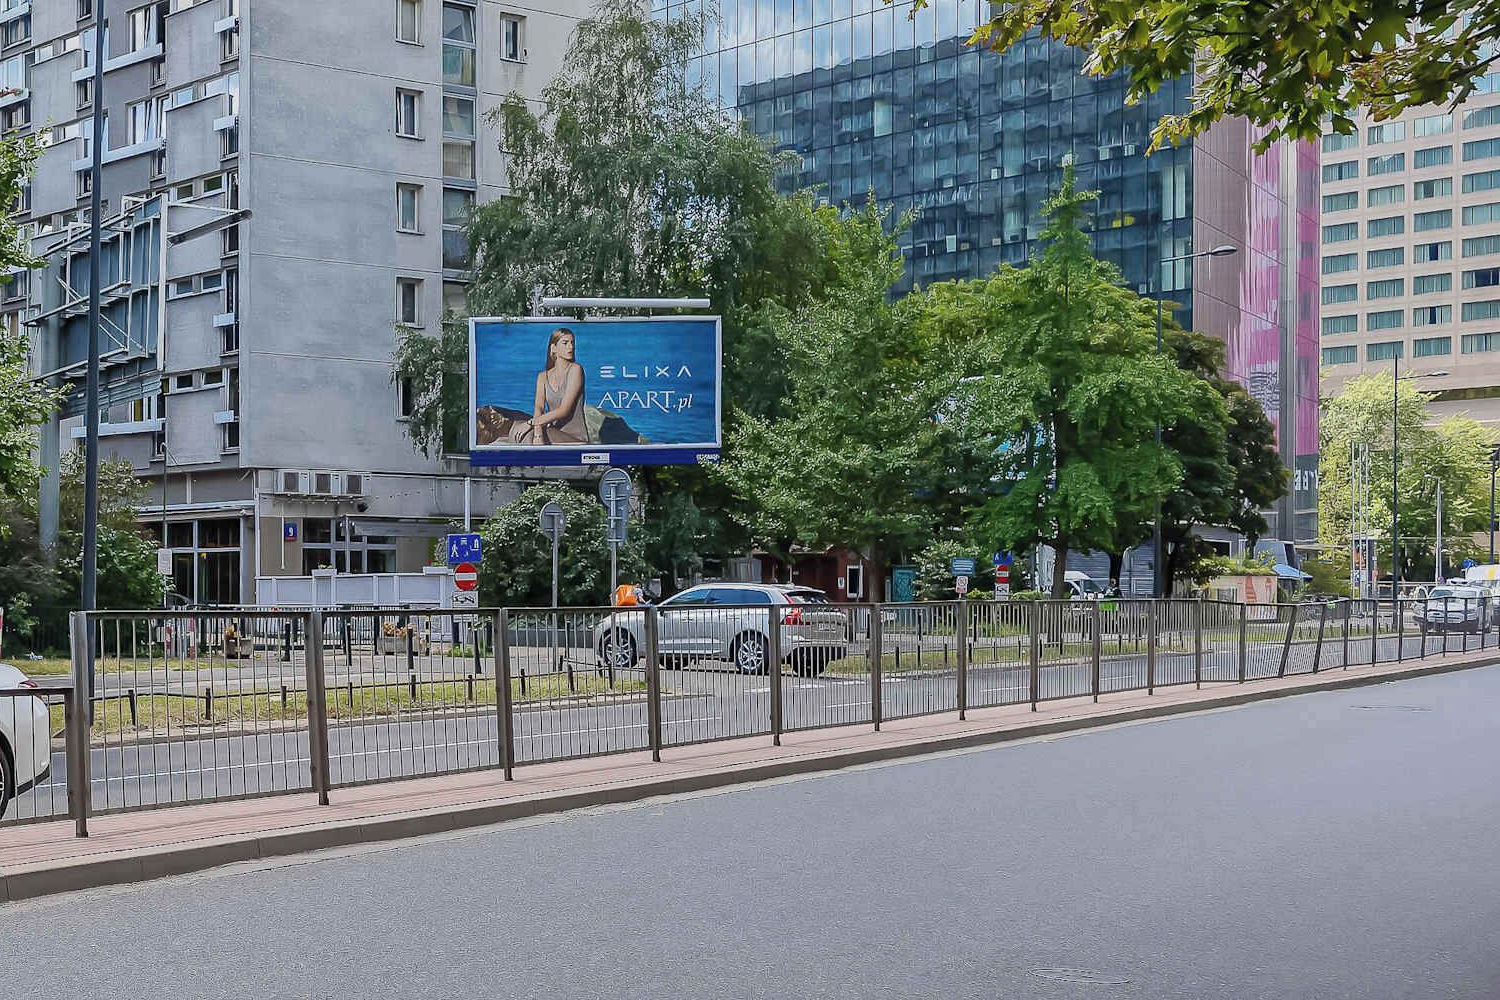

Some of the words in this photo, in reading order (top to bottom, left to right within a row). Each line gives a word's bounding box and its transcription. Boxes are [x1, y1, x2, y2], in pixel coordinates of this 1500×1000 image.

[599, 365, 693, 378] ELIXA
[596, 390, 693, 414] APART.pl
[288, 526, 295, 537] 9
